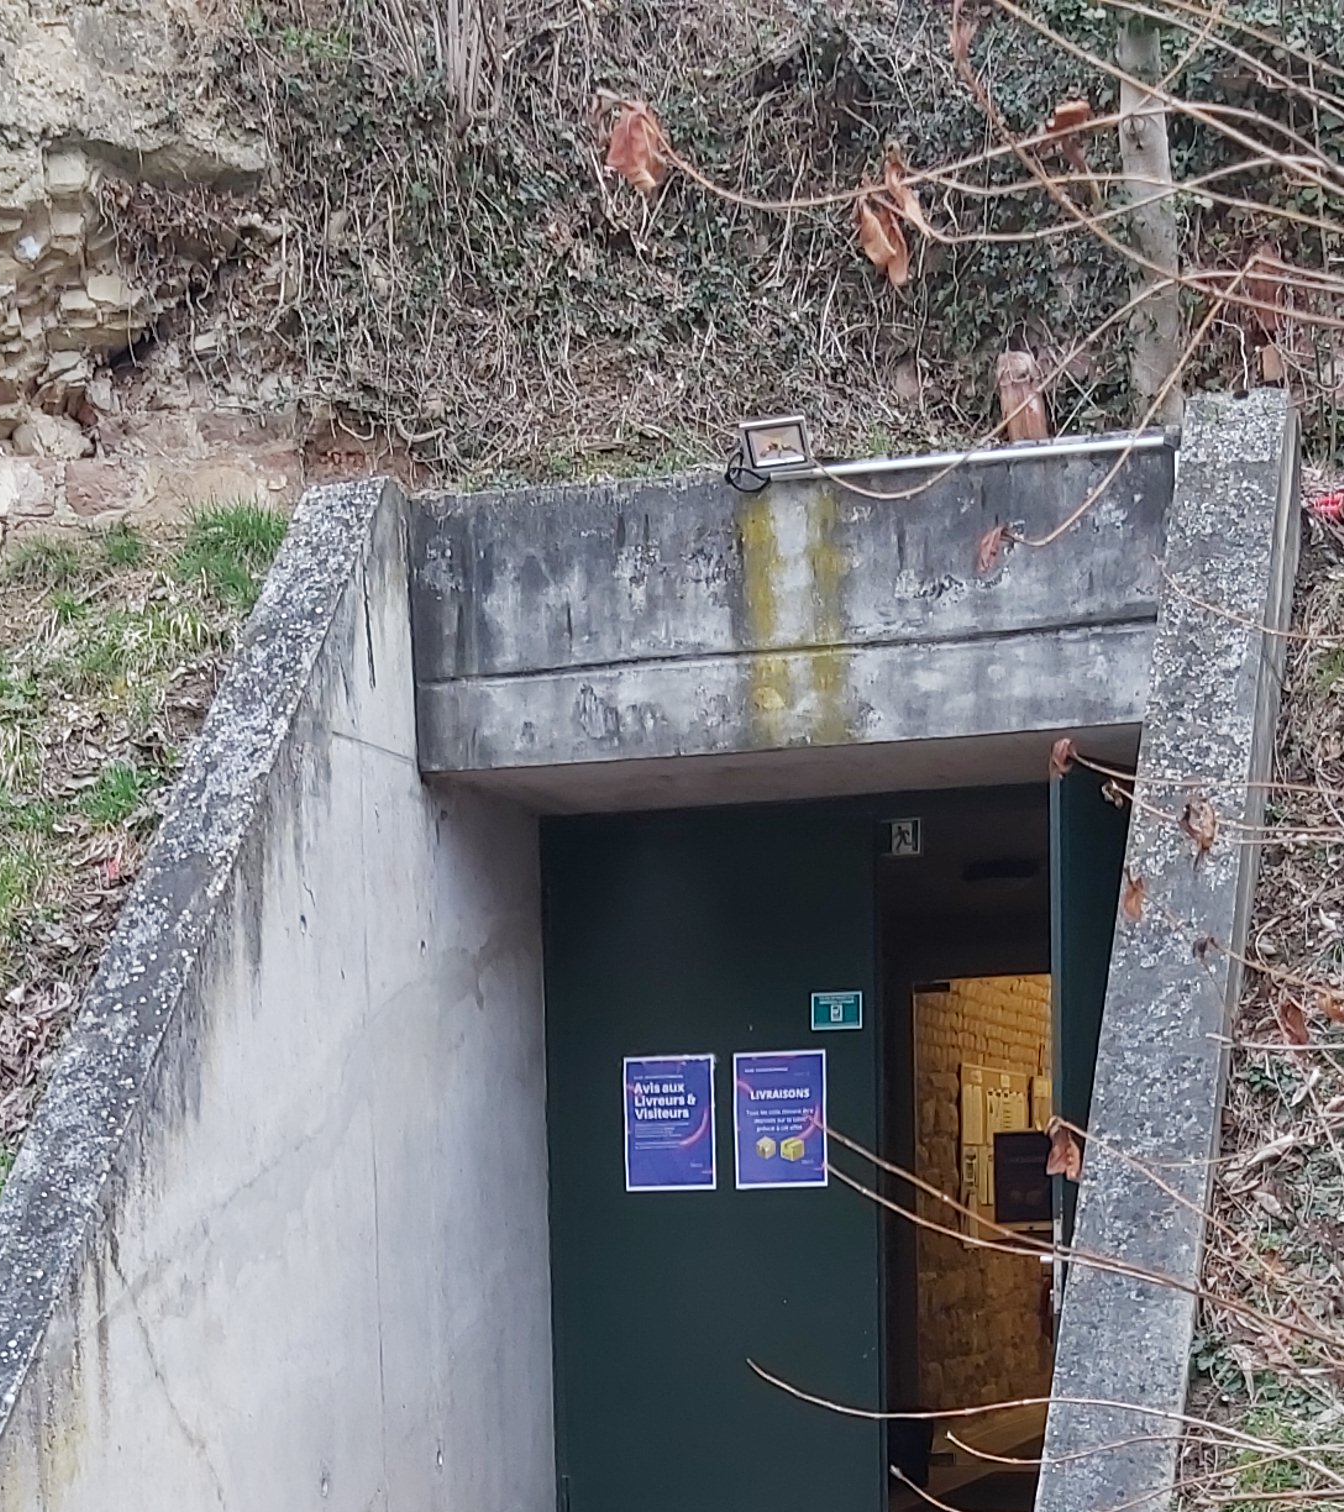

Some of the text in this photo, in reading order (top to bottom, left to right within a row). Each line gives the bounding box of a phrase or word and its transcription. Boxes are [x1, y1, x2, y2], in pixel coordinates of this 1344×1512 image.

[634, 1081, 685, 1094] Avis aux
[750, 1088, 810, 1100] LIVRAISONS
[634, 1093, 696, 1107] Livreurs &
[634, 1107, 690, 1120] Visiteurs
